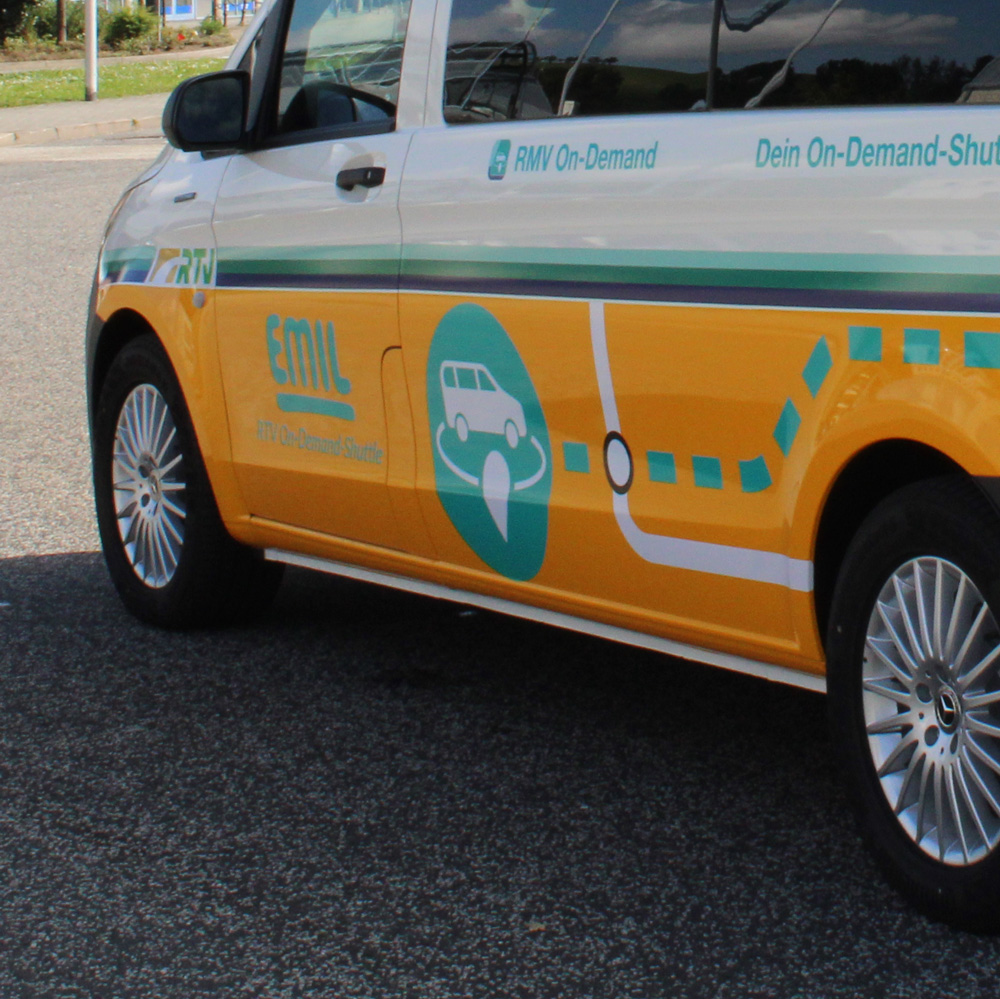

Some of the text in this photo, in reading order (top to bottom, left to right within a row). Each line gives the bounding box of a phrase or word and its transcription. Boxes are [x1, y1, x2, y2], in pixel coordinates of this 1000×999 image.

[514, 140, 659, 172] RMV On-Demand
[755, 137, 800, 168] Dein
[176, 248, 215, 285] RTV
[265, 313, 352, 395] EMIL
[280, 423, 385, 465] On-Demand-Shuttle
